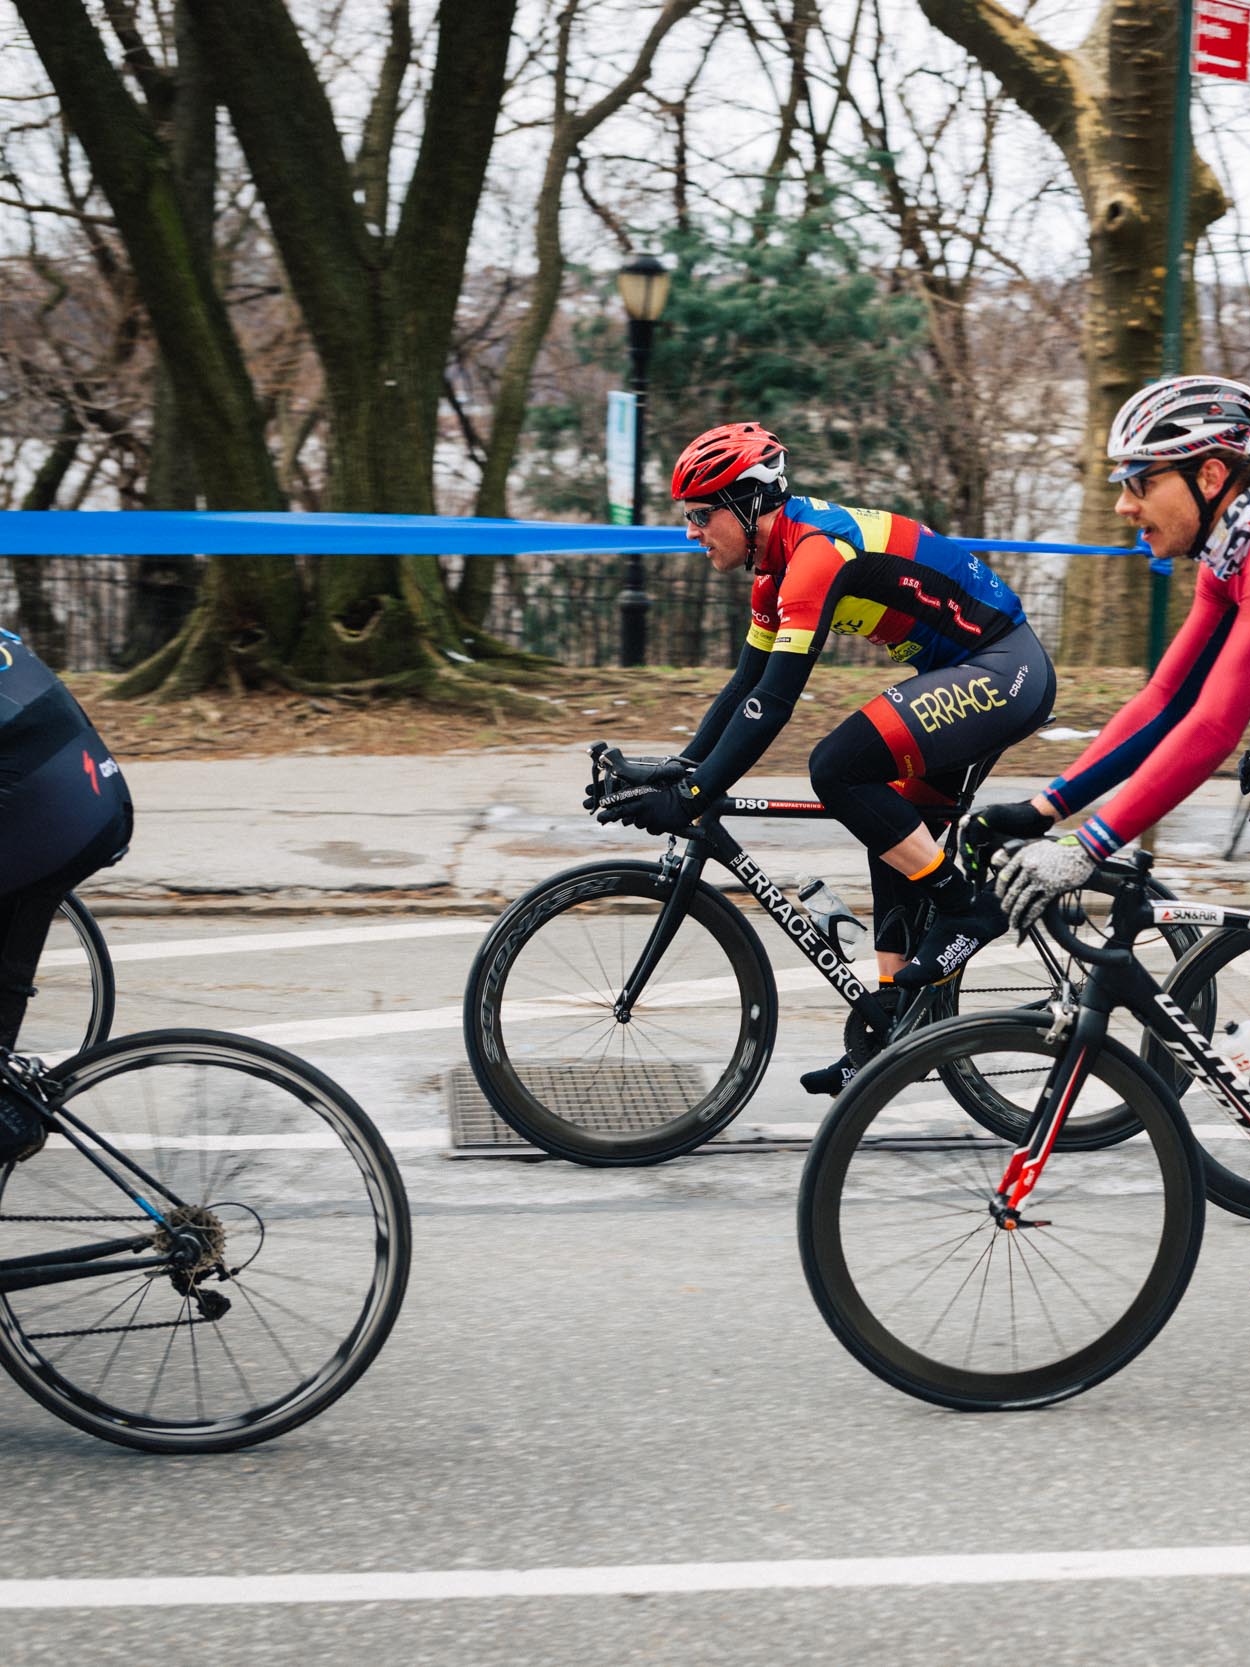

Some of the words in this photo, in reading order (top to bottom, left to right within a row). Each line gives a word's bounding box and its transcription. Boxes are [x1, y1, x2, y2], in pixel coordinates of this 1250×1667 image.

[1009, 671, 1027, 698] CRAFT
[909, 676, 1008, 733] ERRACE
[735, 798, 769, 810] DSO
[771, 801, 822, 809] MANUFACTURING
[736, 857, 865, 1001] ERRACE.ORG
[936, 933, 971, 968] DeFeet
[942, 937, 980, 977] SLIPSTREAM
